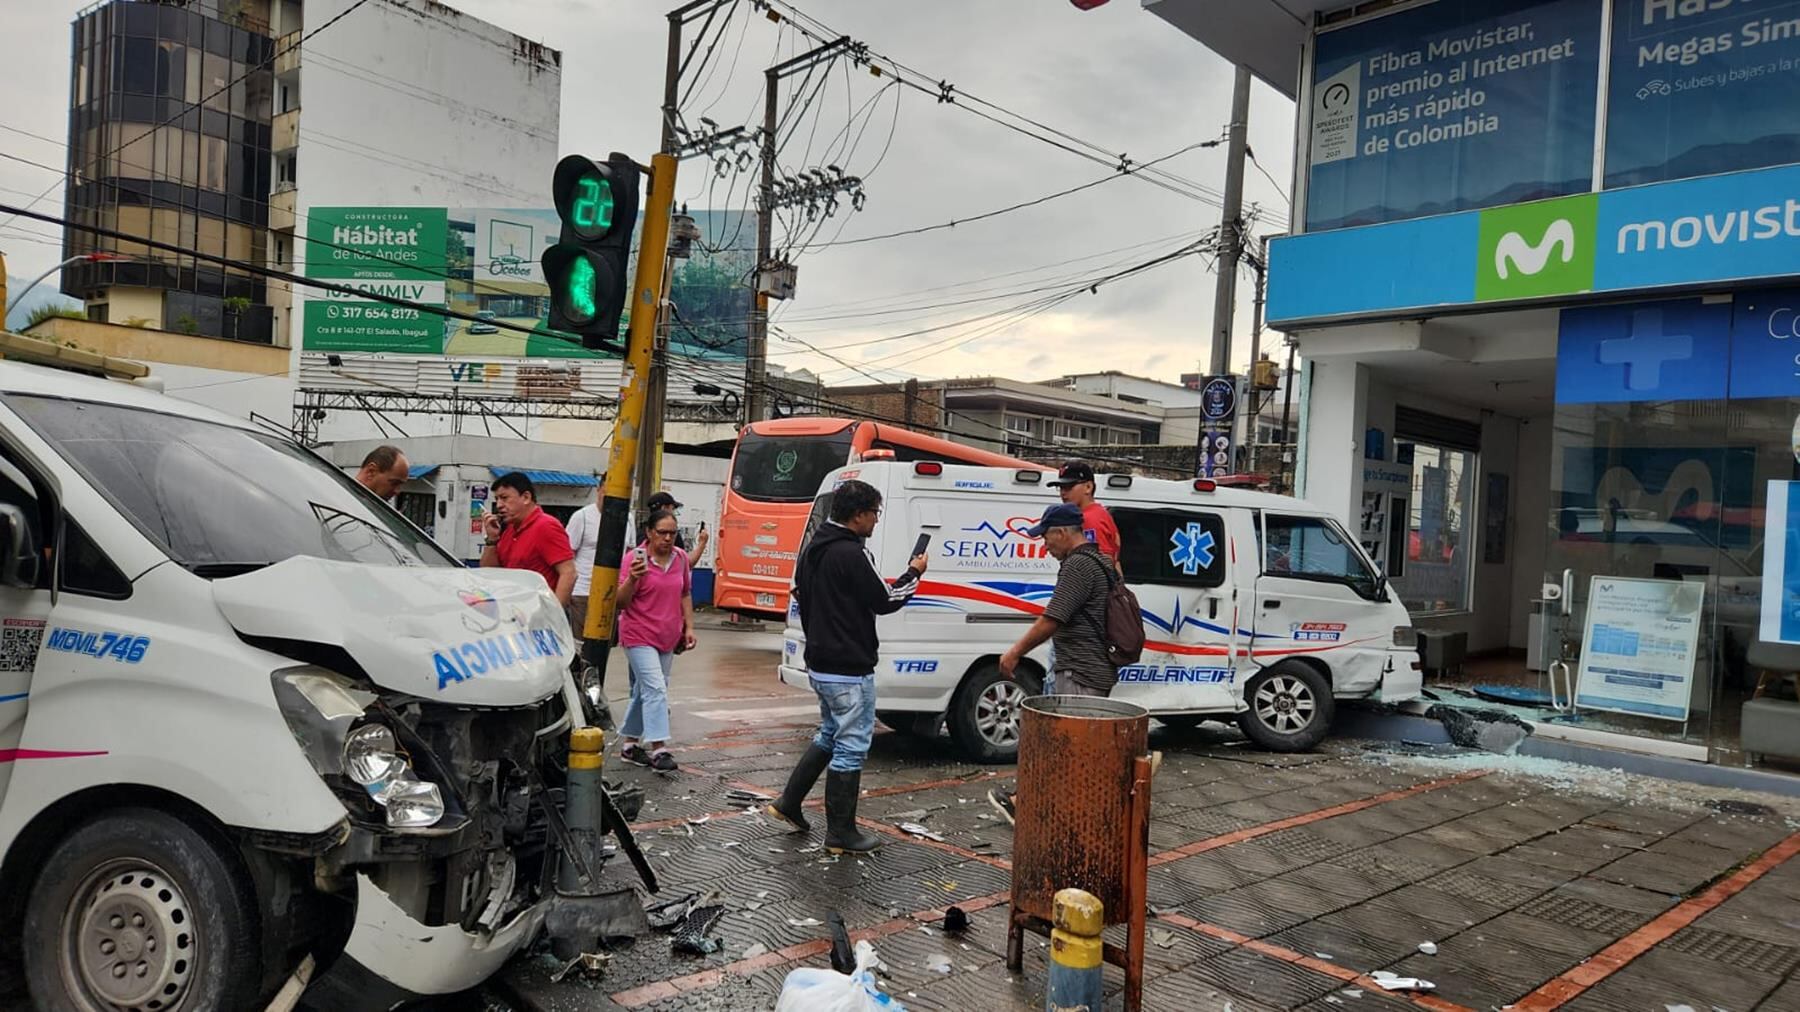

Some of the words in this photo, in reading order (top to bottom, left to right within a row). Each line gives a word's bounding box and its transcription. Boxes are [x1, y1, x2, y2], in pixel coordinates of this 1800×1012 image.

[1368, 51, 1421, 77] Fibra
[1427, 22, 1534, 61] Movistar,
[1638, 33, 1733, 67] Megas
[1366, 71, 1443, 108] premio
[1448, 66, 1466, 85] al
[1473, 38, 1575, 78] Internet
[1674, 75, 1714, 91] Subes
[1717, 73, 1727, 87] y
[1729, 66, 1765, 82] bajas
[1767, 62, 1776, 73] a
[1779, 58, 1792, 71] la
[1365, 105, 1409, 130] más
[1415, 88, 1486, 120] rápido
[1364, 135, 1389, 156] de
[1394, 113, 1498, 149] Colombia
[573, 179, 613, 227] 22
[333, 224, 418, 246] Hábitat
[333, 249, 350, 260] de
[354, 249, 372, 261] los
[376, 249, 418, 262] Andes
[342, 307, 362, 318] 317
[365, 308, 389, 319] 654
[391, 308, 419, 320] 8173
[957, 560, 1030, 570] AMBULANCIAS
[893, 660, 938, 674] TAB
